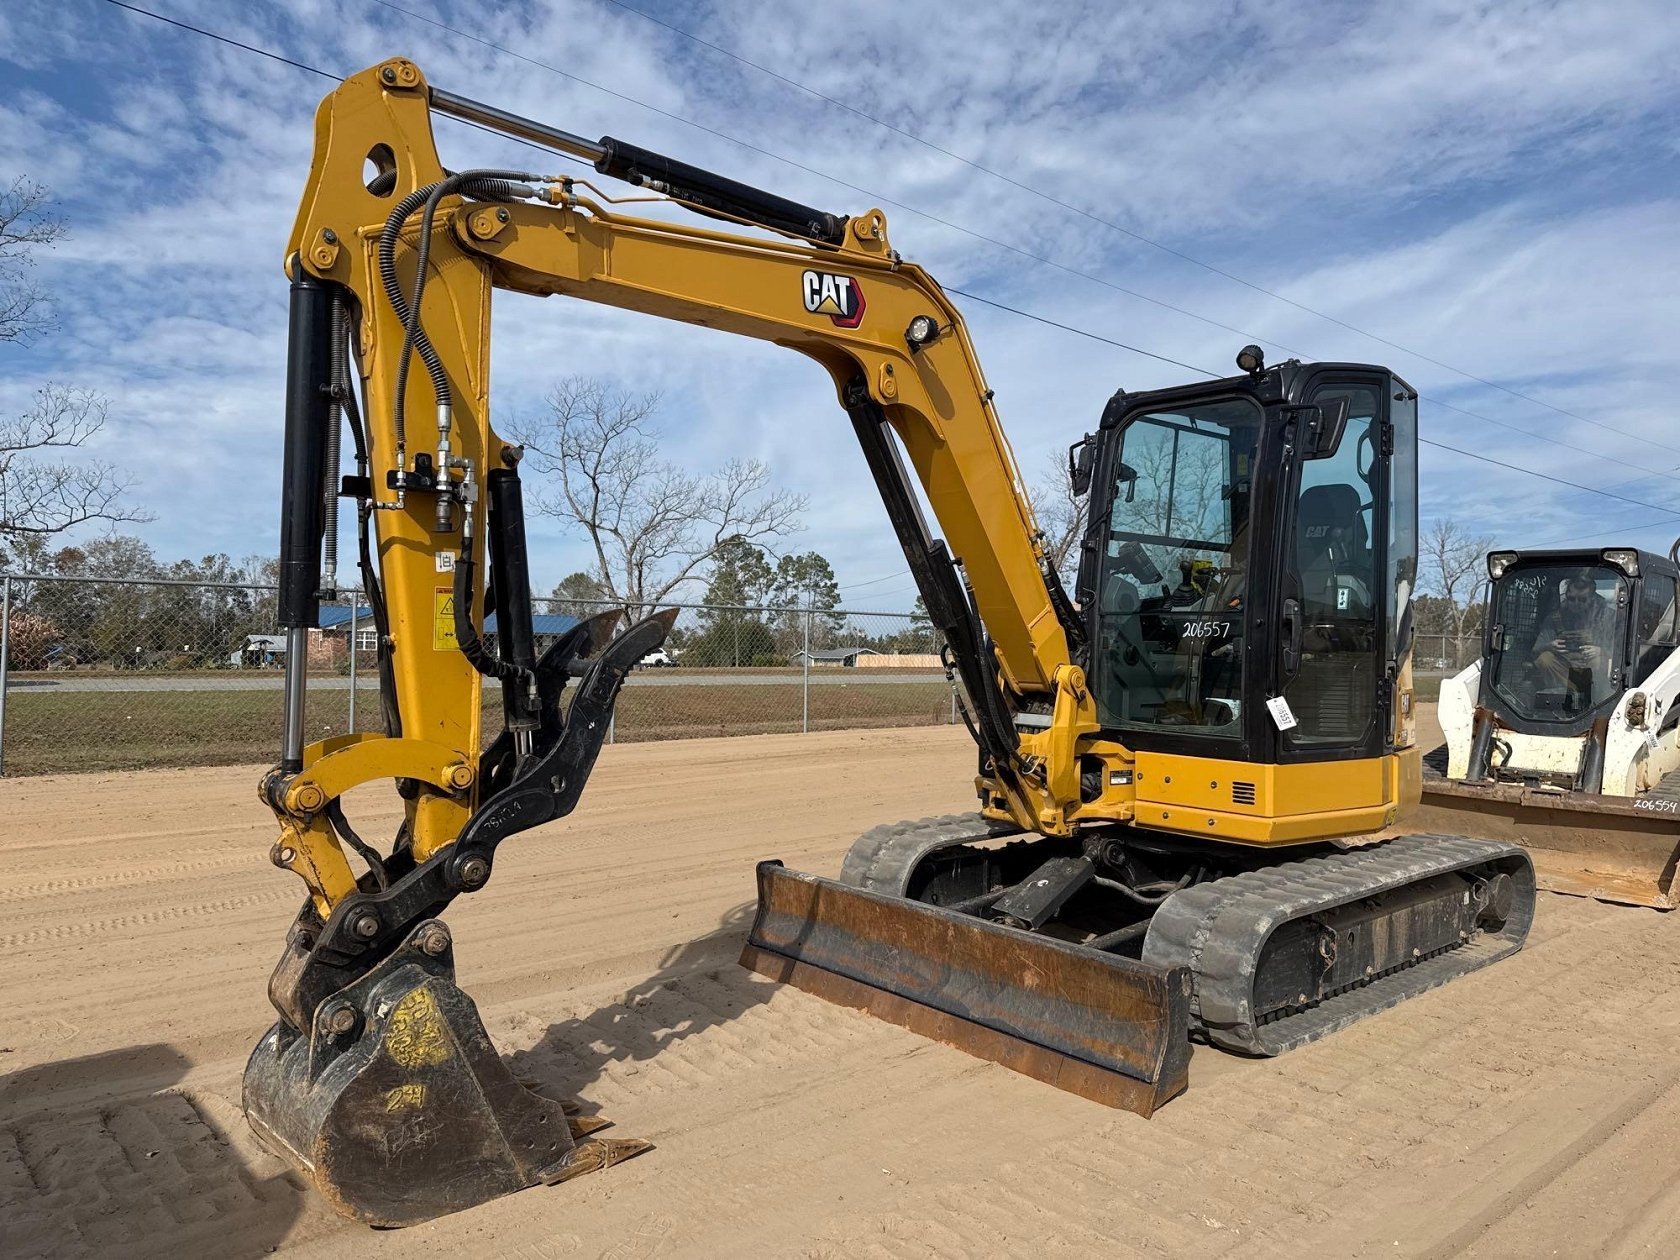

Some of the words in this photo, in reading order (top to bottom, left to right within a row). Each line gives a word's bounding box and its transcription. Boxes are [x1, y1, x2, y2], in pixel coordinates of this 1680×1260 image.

[803, 270, 850, 316] CAT
[1305, 525, 1330, 538] CAT
[1182, 621, 1230, 638] 206557
[1633, 799, 1678, 813] 206554
